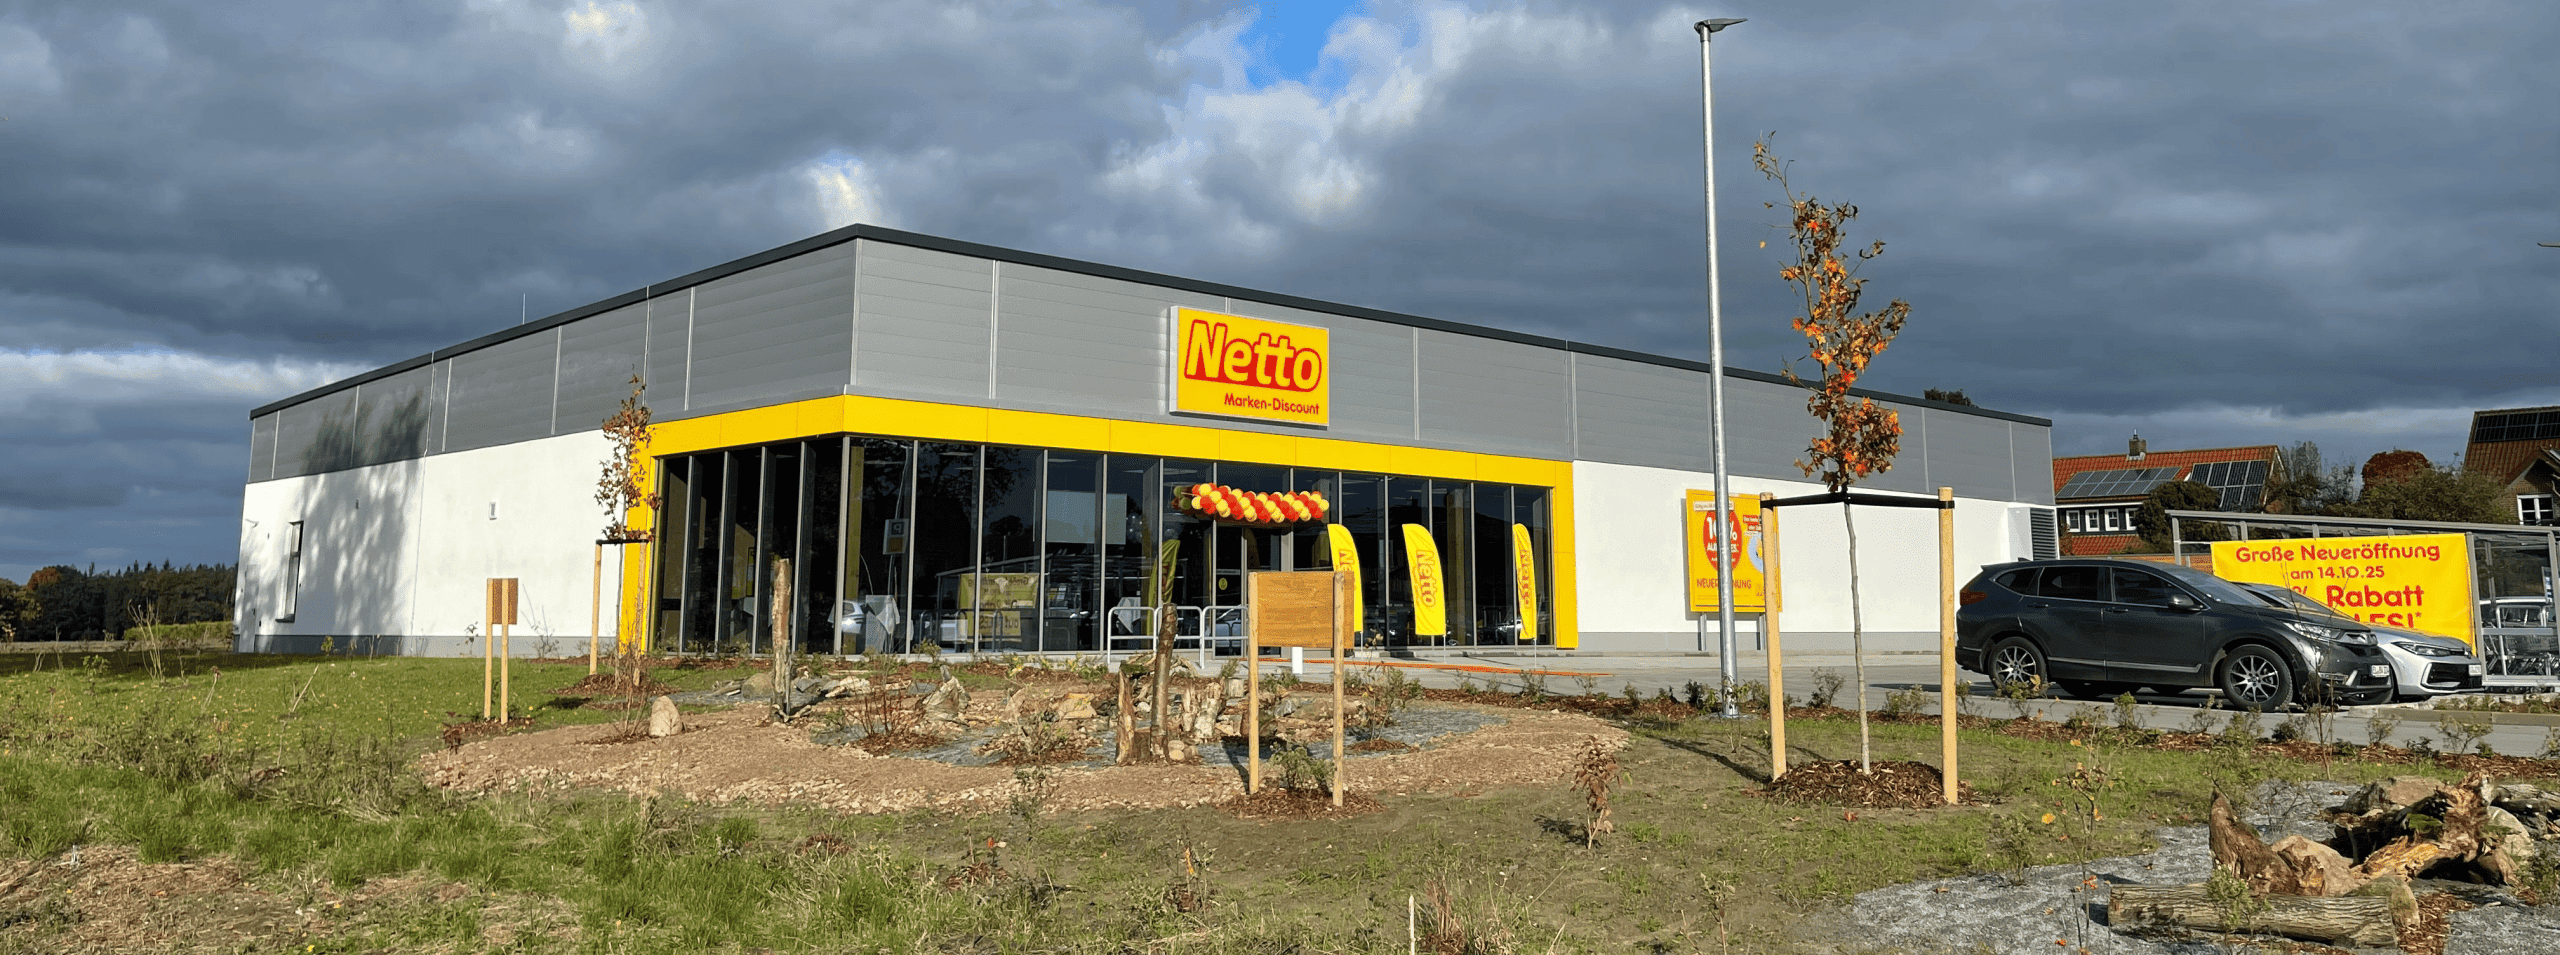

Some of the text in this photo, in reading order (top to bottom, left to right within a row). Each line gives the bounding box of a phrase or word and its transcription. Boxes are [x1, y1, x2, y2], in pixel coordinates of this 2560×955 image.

[1184, 319, 1322, 392] Netto
[1224, 392, 1320, 415] Marken-Discount
[2235, 543, 2441, 563] Große Neueröffnung
[1415, 549, 1437, 608] Netto
[2290, 565, 2386, 580] am 14.10.25
[2326, 584, 2425, 608] Rabatt
